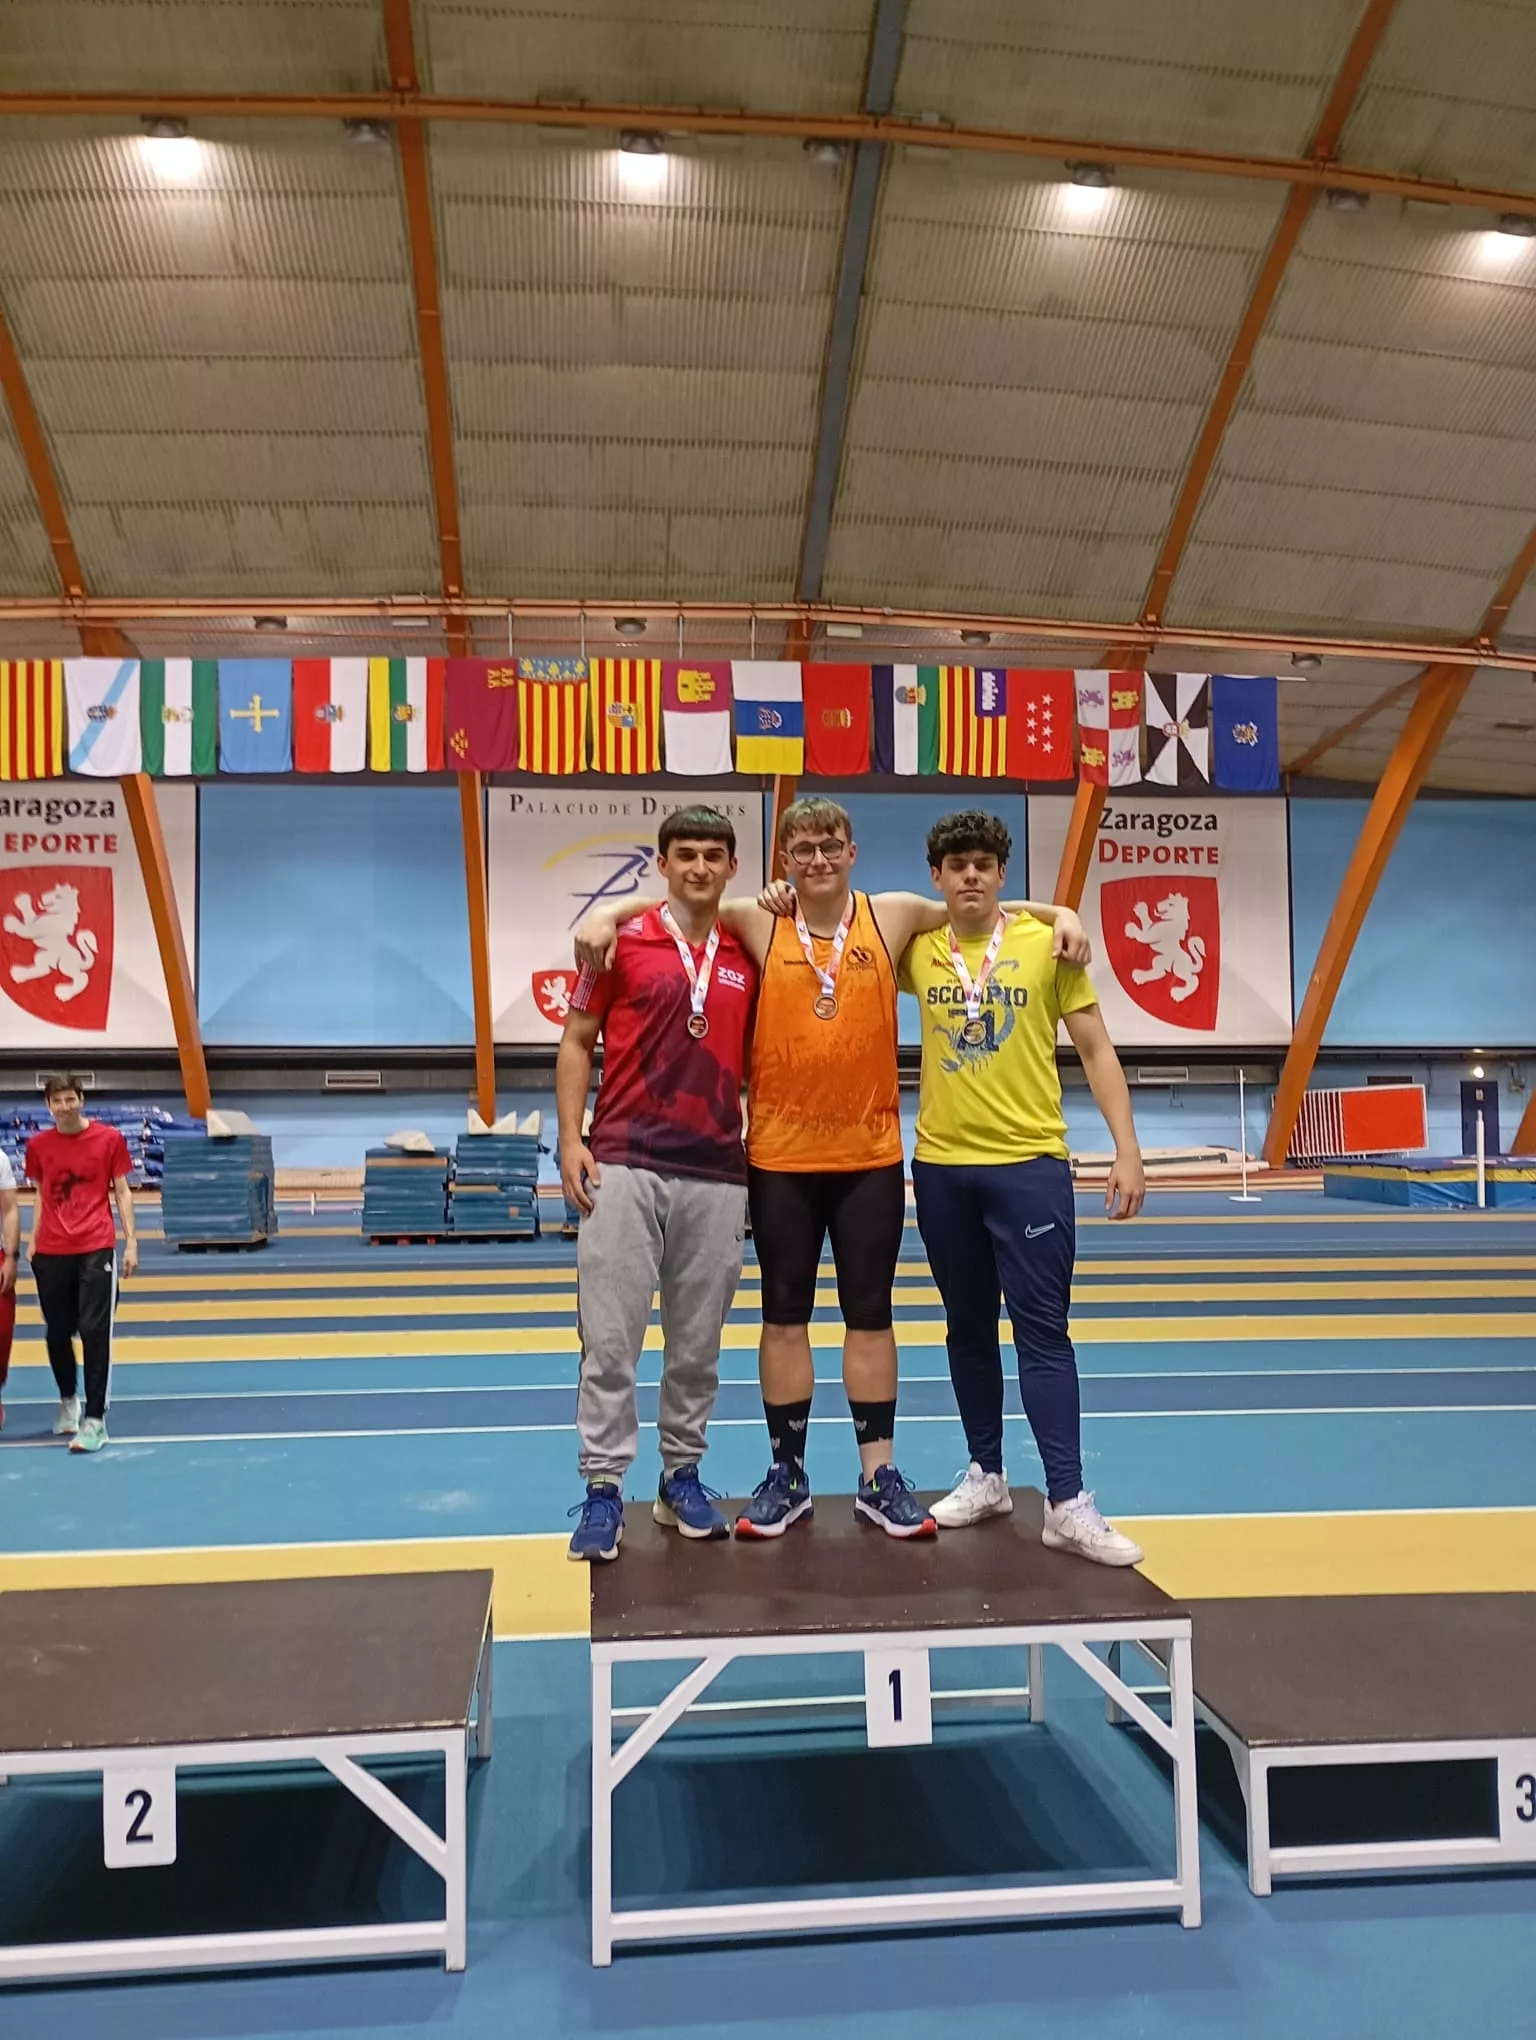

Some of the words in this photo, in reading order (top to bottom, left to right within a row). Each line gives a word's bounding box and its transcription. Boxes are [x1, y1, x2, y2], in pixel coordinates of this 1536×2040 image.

[0, 797, 116, 826] aragoza
[509, 794, 599, 816] PALACIO
[608, 803, 632, 816] DE
[641, 796, 746, 817] DEPTES
[1098, 806, 1219, 838] Zaragoza
[4, 832, 119, 854] EPORTE
[1098, 838, 1220, 865] DEPORTE
[888, 1668, 903, 1723] 1
[1515, 1772, 1536, 1823] 3
[124, 1787, 154, 1846] 2
